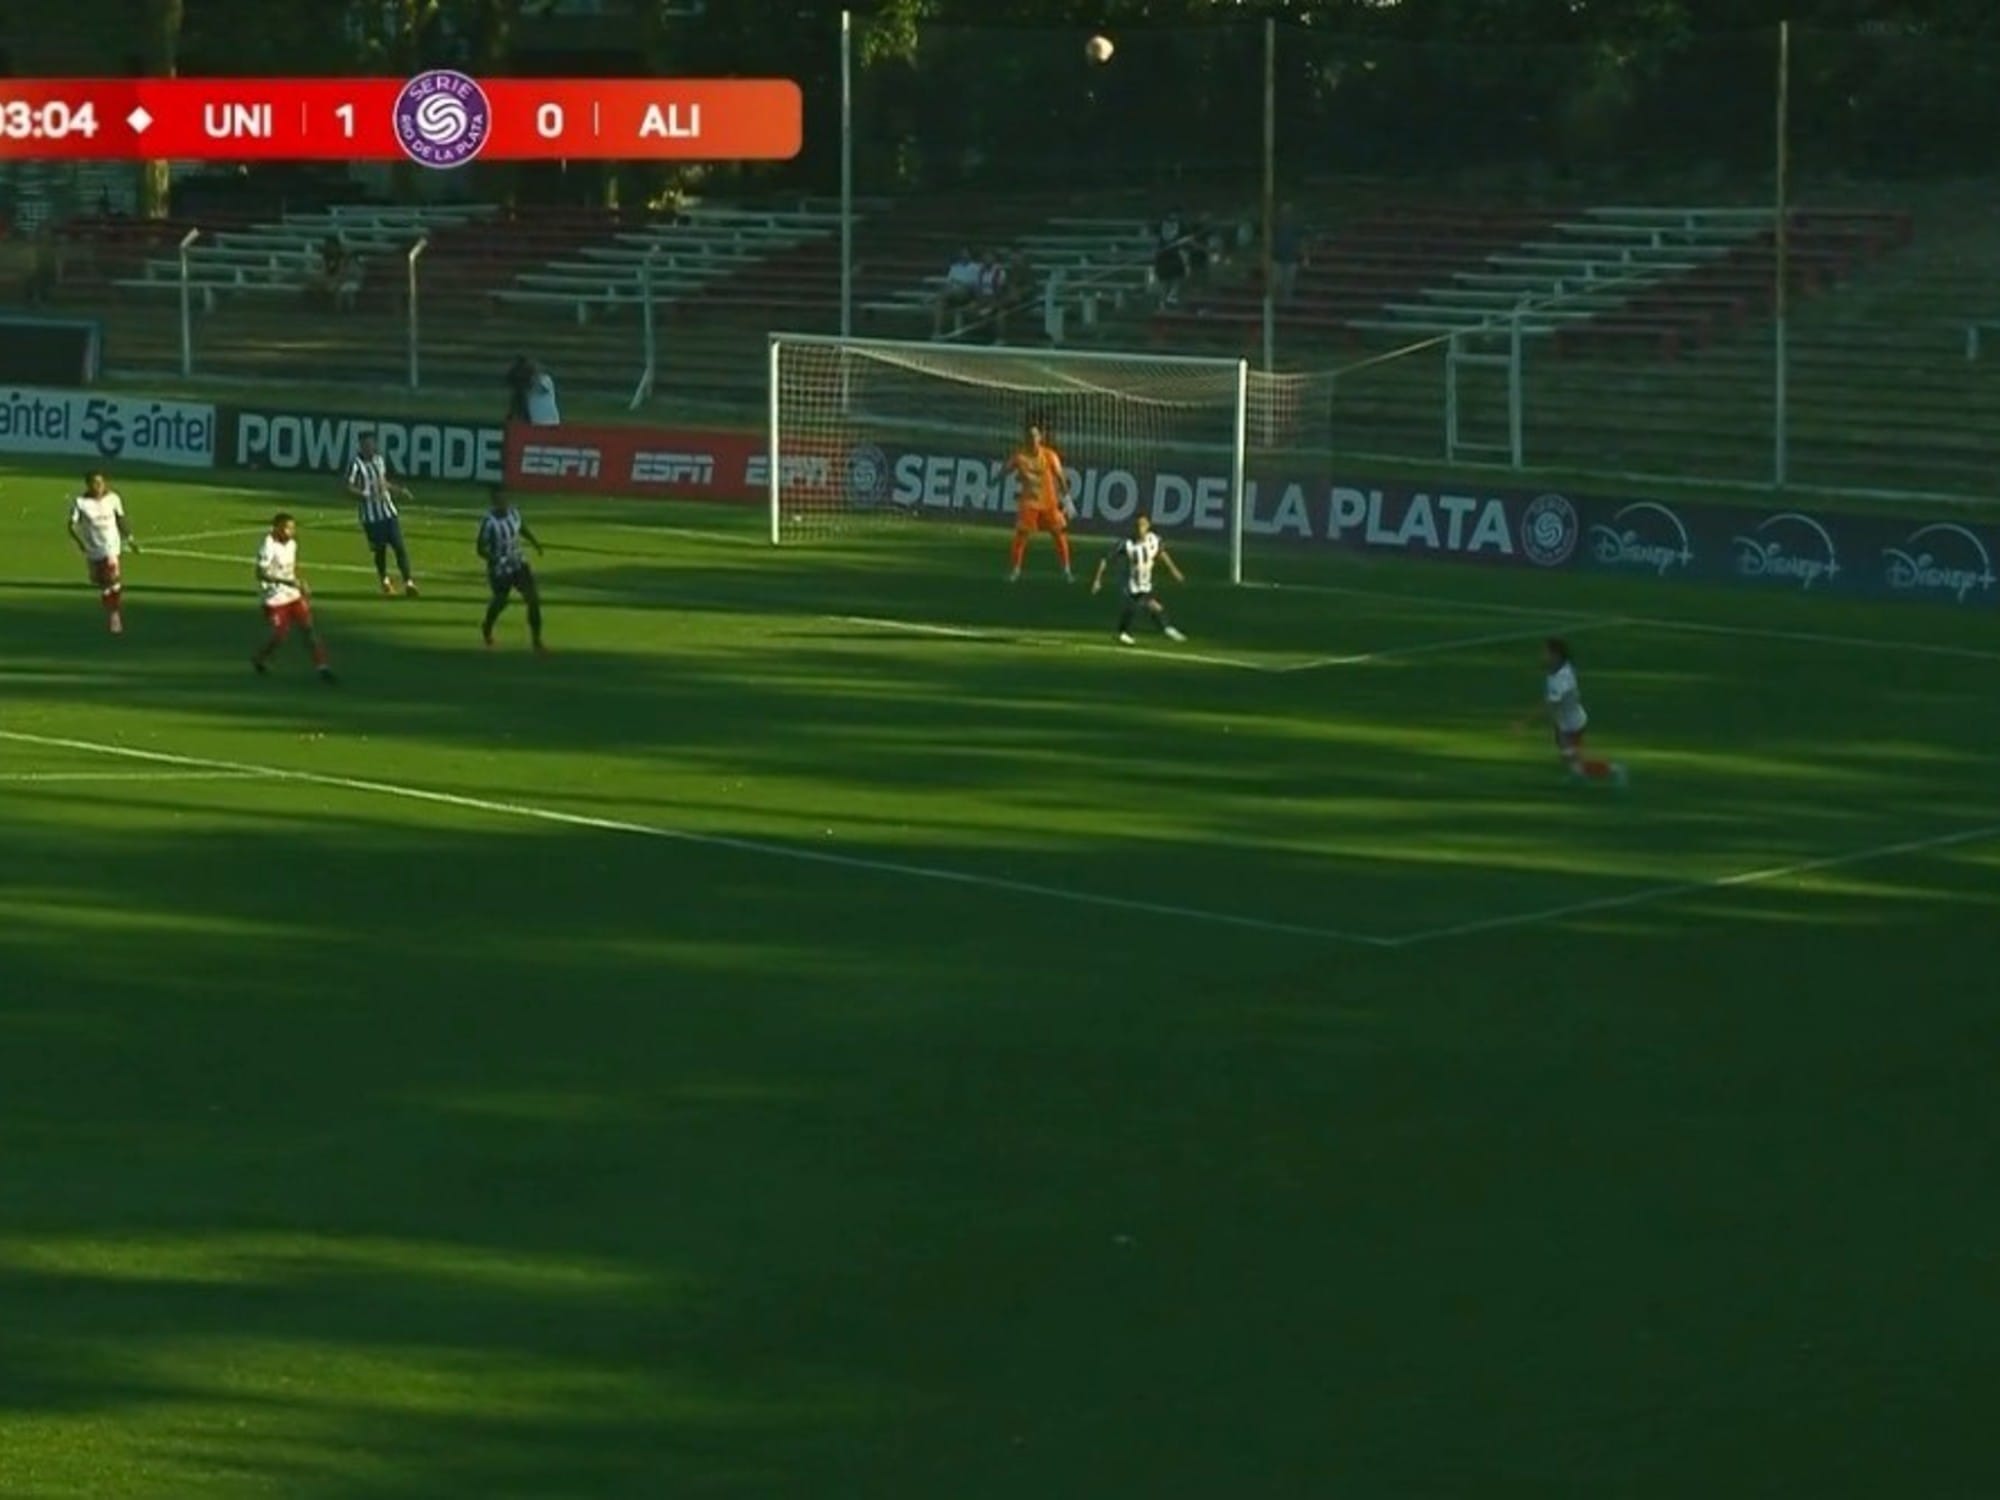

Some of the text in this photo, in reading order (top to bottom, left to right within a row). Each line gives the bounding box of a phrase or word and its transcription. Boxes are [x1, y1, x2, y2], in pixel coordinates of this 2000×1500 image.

[81, 399, 125, 457] 5G
[132, 403, 212, 453] antel
[521, 446, 600, 478] ESPN
[631, 452, 714, 484] ESPN
[1151, 474, 1228, 530] DE
[1241, 481, 1312, 537] LA
[1327, 487, 1513, 554] PLATA
